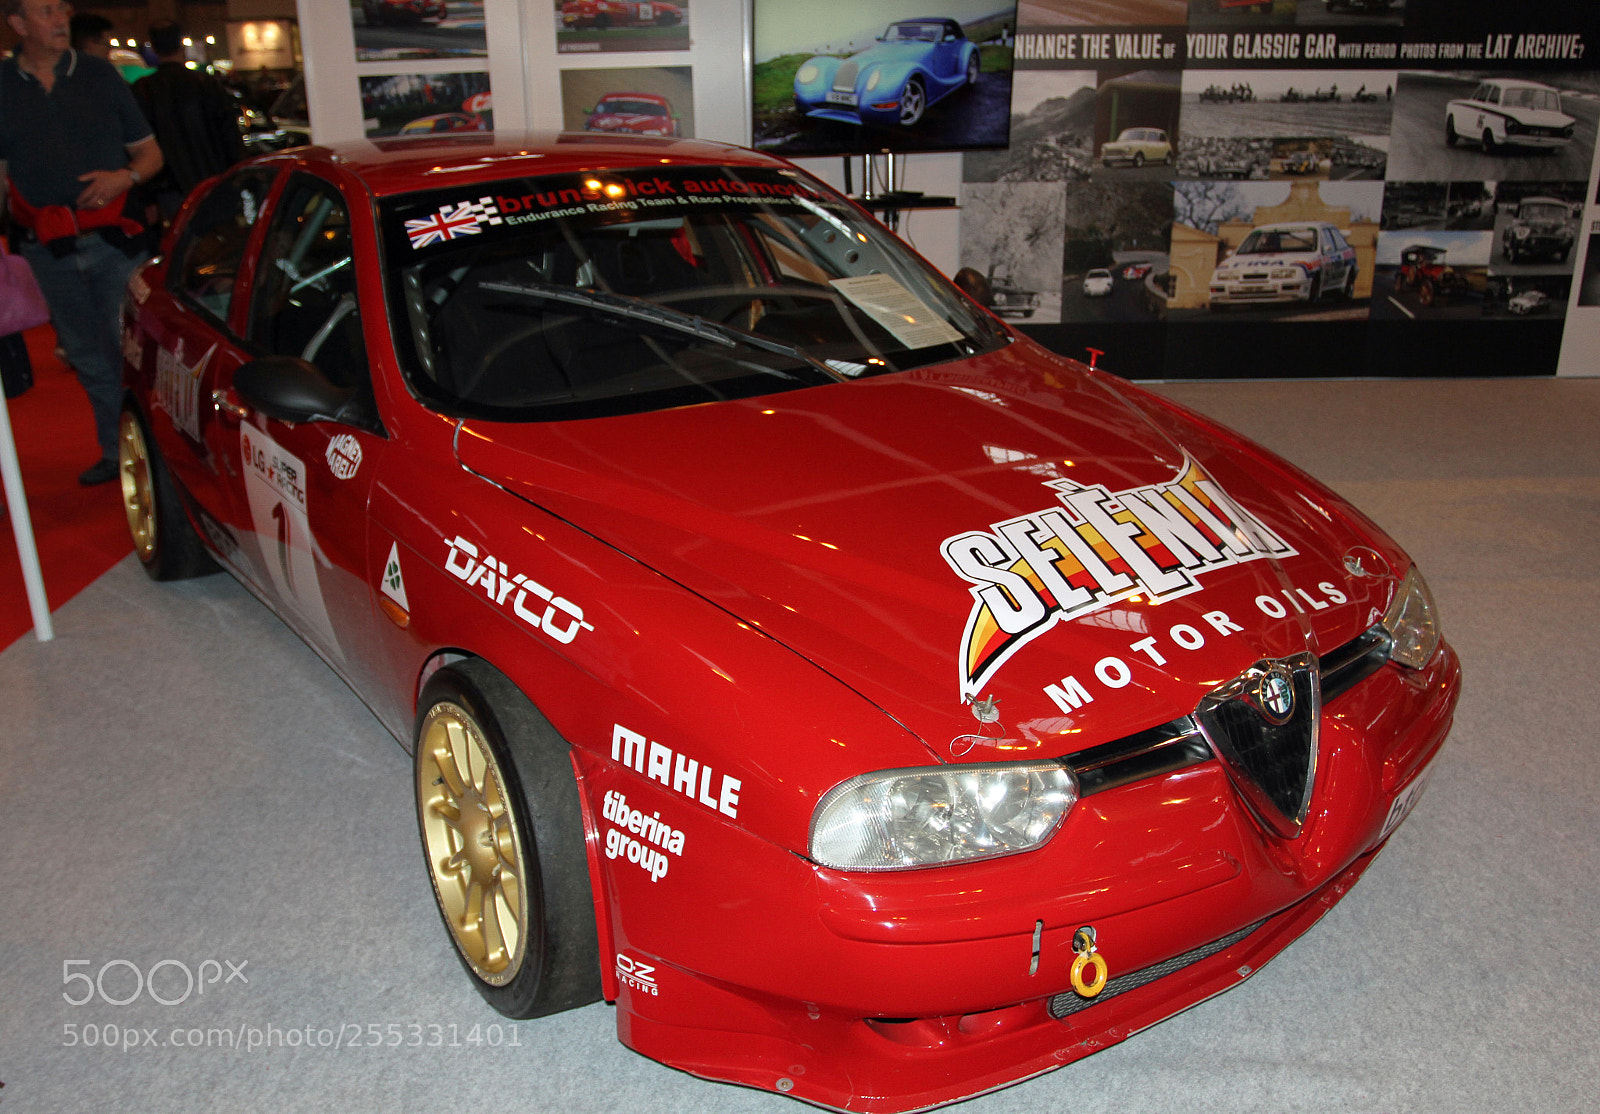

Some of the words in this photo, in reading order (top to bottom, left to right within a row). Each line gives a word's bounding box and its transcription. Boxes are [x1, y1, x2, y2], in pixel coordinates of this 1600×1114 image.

[1081, 33, 1110, 59] THE
[1115, 33, 1163, 59] VALUE
[1163, 43, 1176, 59] OF
[1186, 33, 1228, 59] YOUR
[1233, 33, 1300, 59] CLASSIC
[1305, 33, 1336, 59] CAR
[1338, 44, 1361, 59] WITH
[1363, 43, 1397, 59] PERIOD
[1400, 43, 1436, 59] PHOTOS
[1439, 43, 1464, 59] FROM
[1466, 43, 1483, 59] THE
[1485, 34, 1512, 59] LAT
[1514, 34, 1585, 59] ARCHIVE?
[496, 177, 677, 213] brunsick
[505, 207, 585, 225] Endurance
[586, 199, 638, 213] Racing
[636, 196, 675, 207] Team
[676, 195, 689, 205] &
[689, 195, 722, 205] Race
[252, 445, 266, 473] LG
[444, 535, 595, 645] DAYCO
[1043, 611, 1245, 714] MOTOR
[1255, 581, 1348, 619] OILS
[611, 723, 742, 820] MAHLE
[602, 789, 686, 857] tiberina
[605, 828, 669, 883] group
[615, 970, 659, 997] RACING
